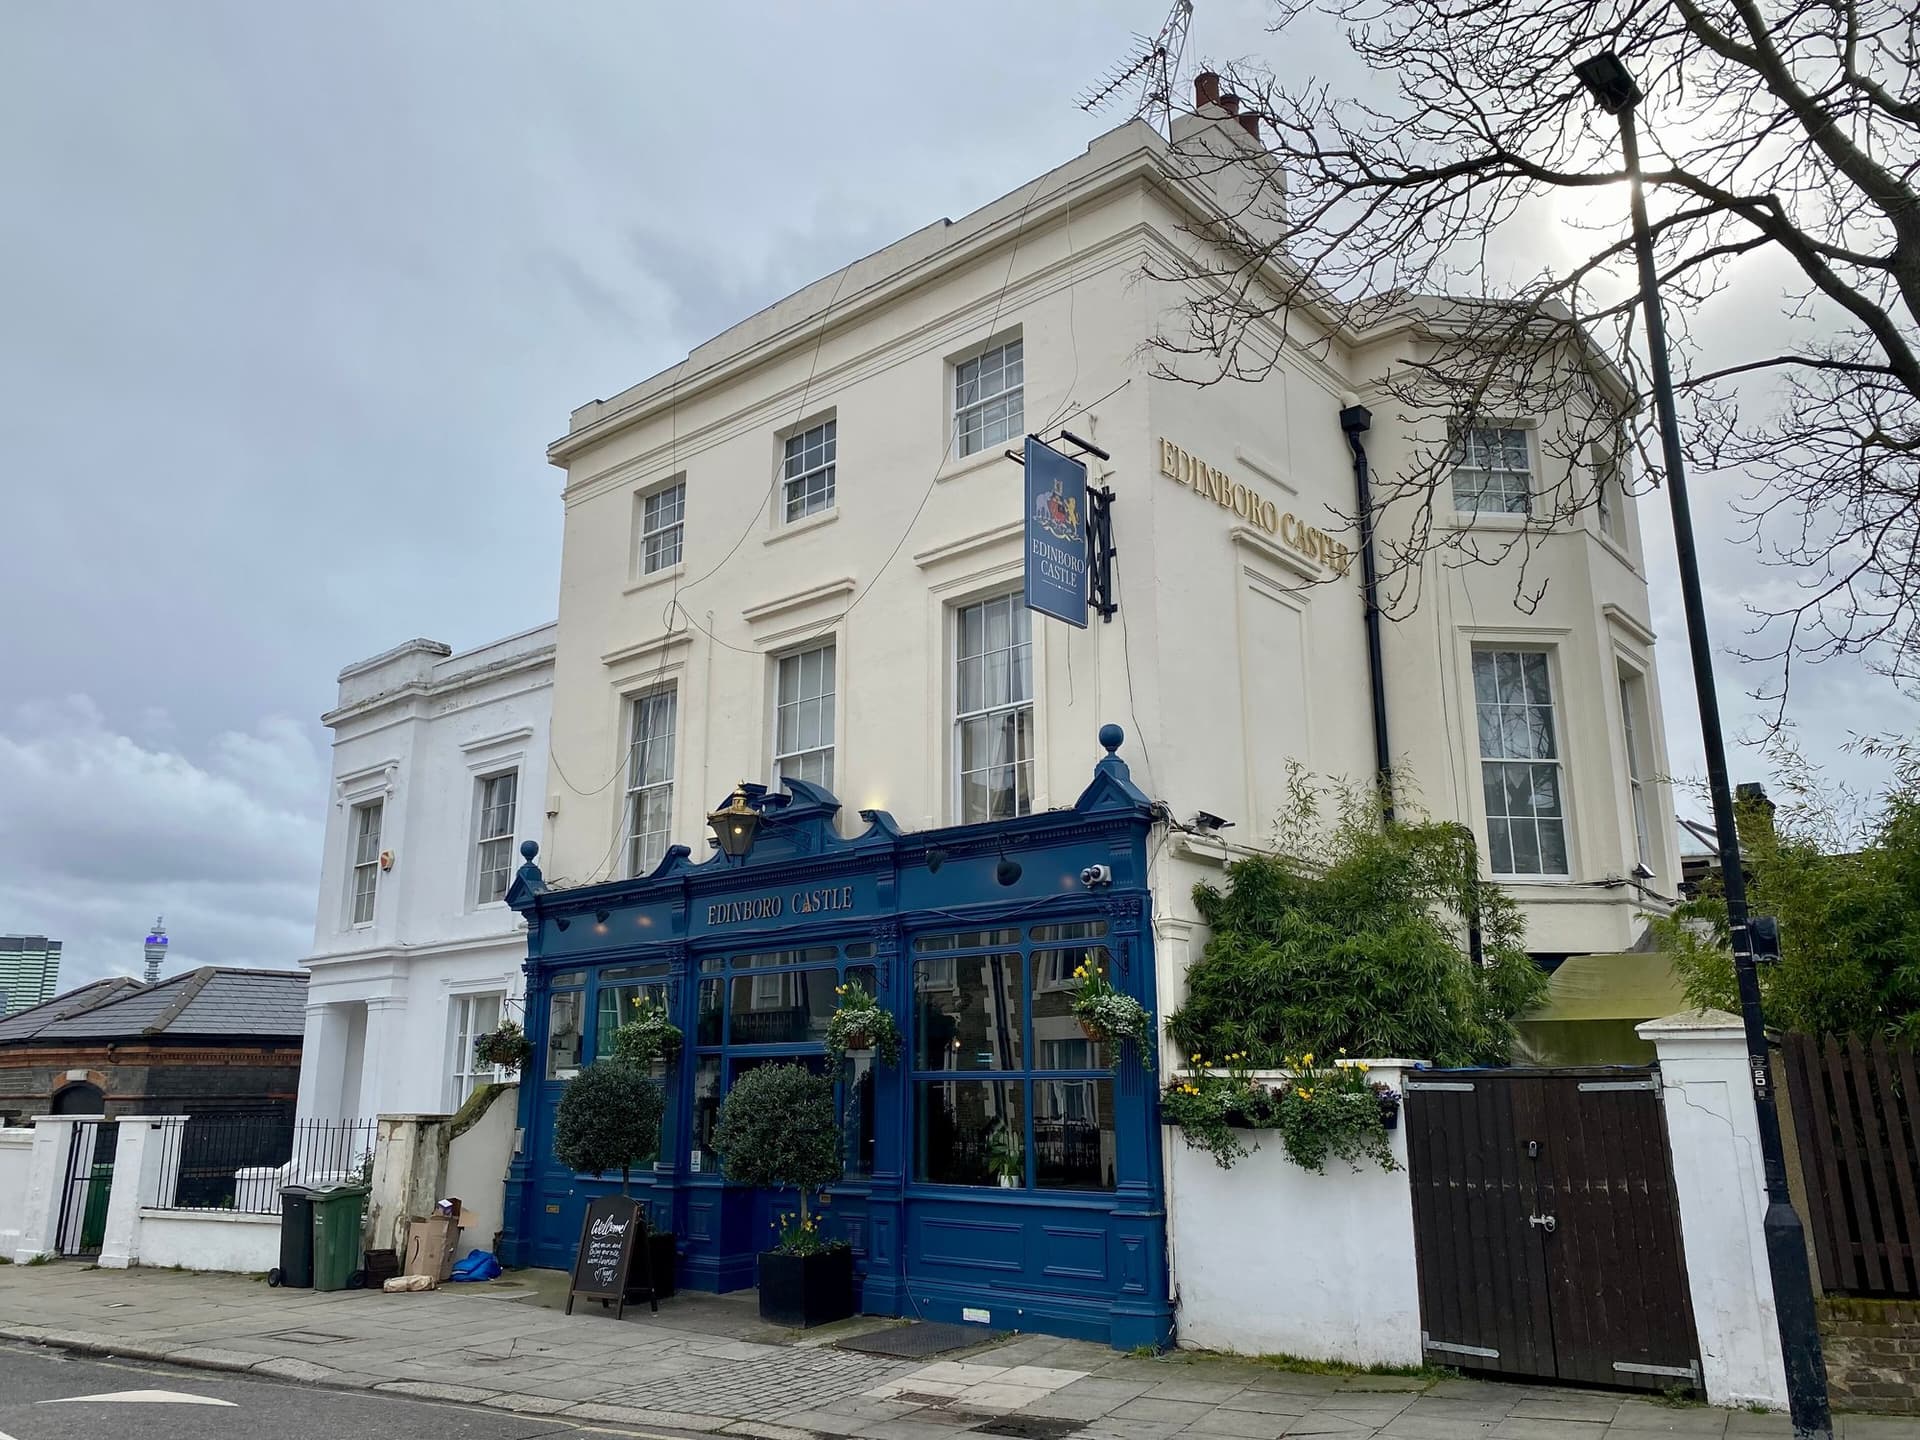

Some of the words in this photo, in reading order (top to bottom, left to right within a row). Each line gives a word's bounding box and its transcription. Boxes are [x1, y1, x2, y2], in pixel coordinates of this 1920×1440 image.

[1160, 437, 1278, 535] EDINBORO
[1032, 539, 1085, 574] EDINBORO
[1040, 558, 1077, 588] CASTLE
[707, 895, 782, 926] EDINBORO
[791, 886, 853, 914] CASTLE
[590, 1214, 630, 1238] Welcome!
